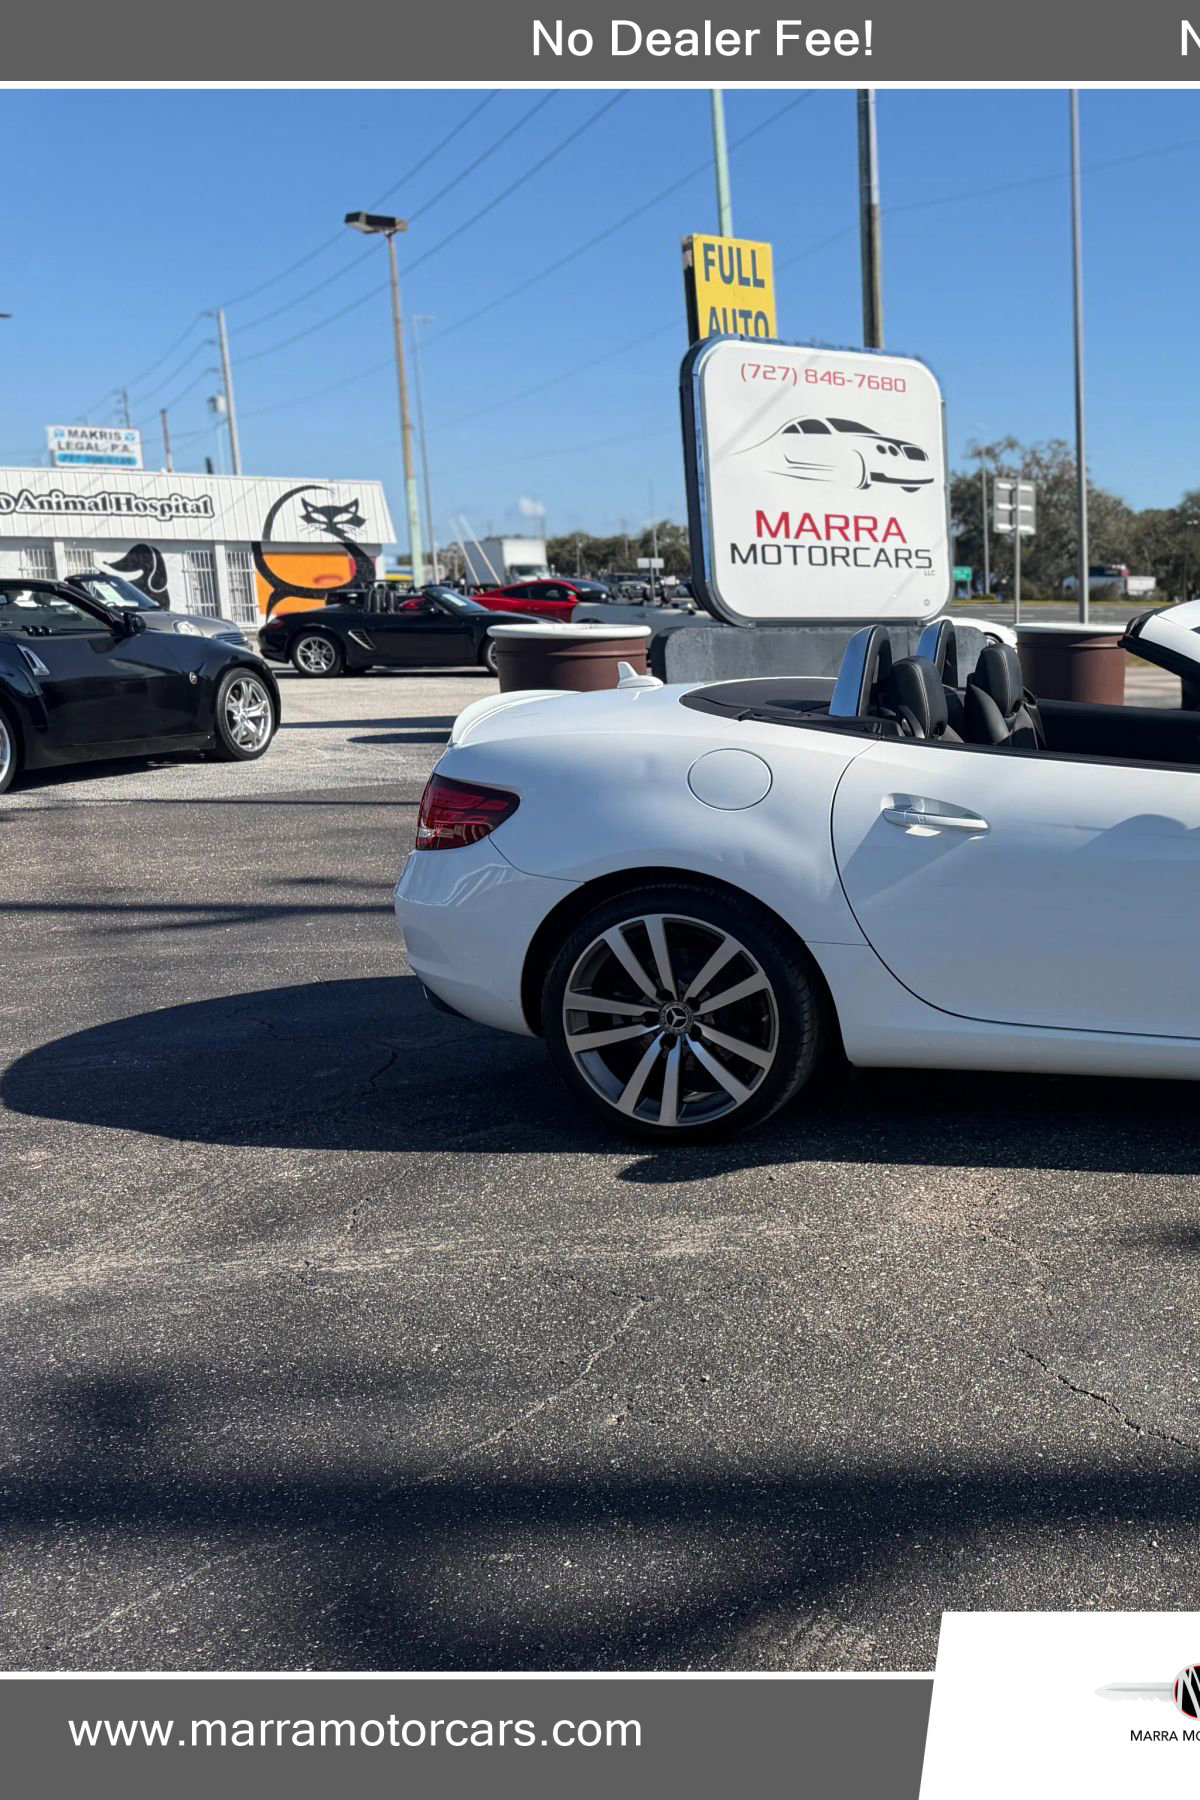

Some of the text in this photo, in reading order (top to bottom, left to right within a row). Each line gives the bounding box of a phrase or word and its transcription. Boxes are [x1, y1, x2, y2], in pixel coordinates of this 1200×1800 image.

[702, 243, 765, 289] FULL
[707, 306, 770, 338] AUTO
[740, 363, 906, 393] (727) 846-7680
[67, 429, 122, 441] MAKRIS
[18, 493, 109, 513] Animal
[112, 496, 210, 518] Hospital
[755, 510, 908, 544] MARRA
[730, 542, 933, 569] MOTORCARS
[923, 569, 936, 577] LLC
